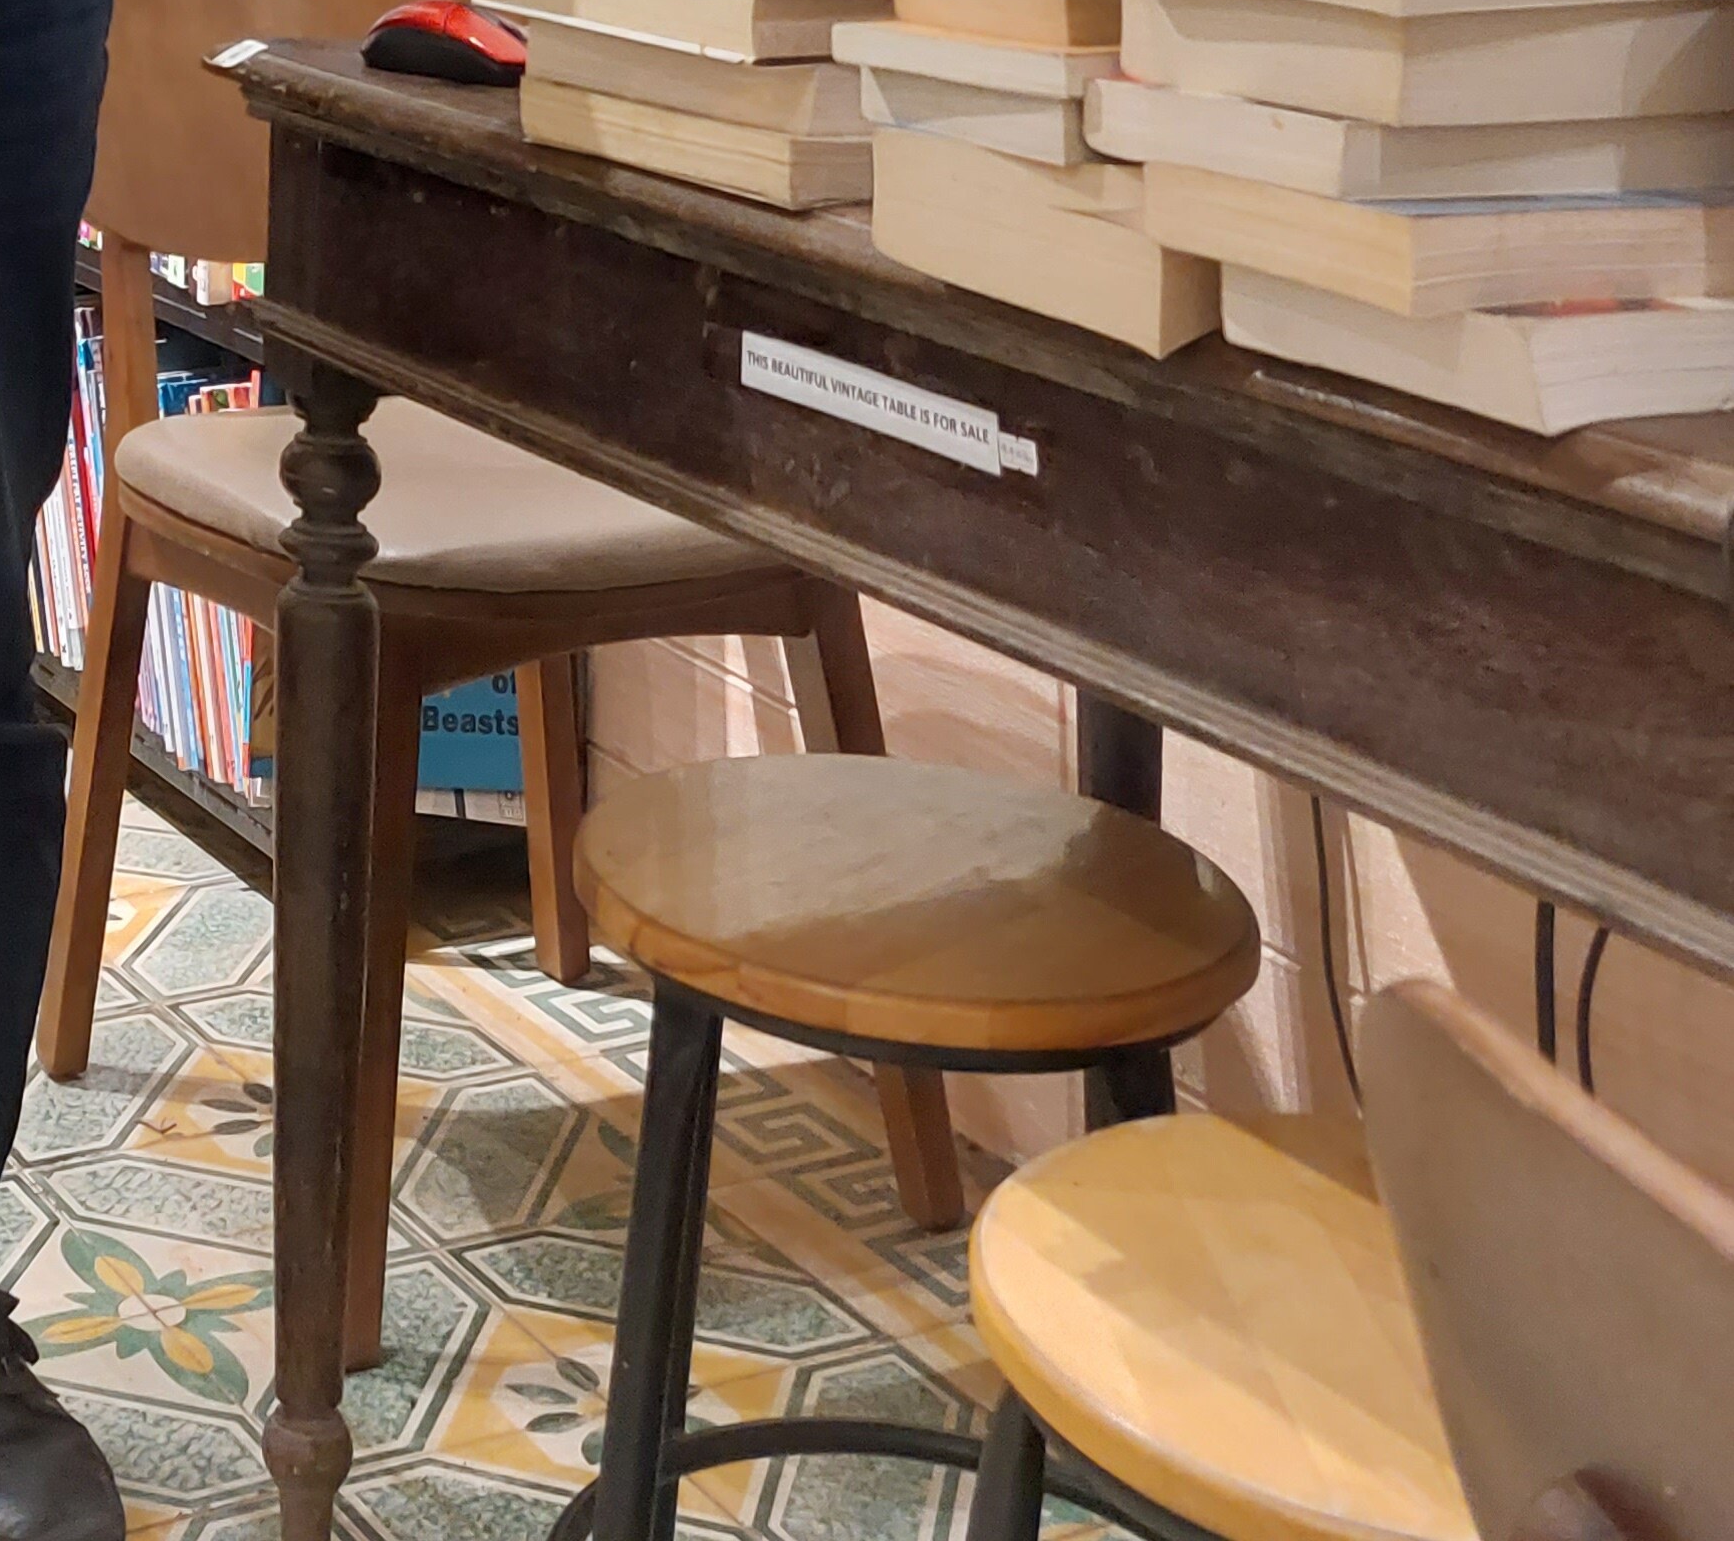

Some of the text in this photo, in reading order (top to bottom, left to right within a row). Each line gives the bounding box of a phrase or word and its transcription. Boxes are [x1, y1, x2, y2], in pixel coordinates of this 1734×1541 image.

[747, 350, 989, 444] THIS BEAUTIFUL VINTAGE TABLE IS FOR SALE
[421, 704, 518, 737] Beasts
